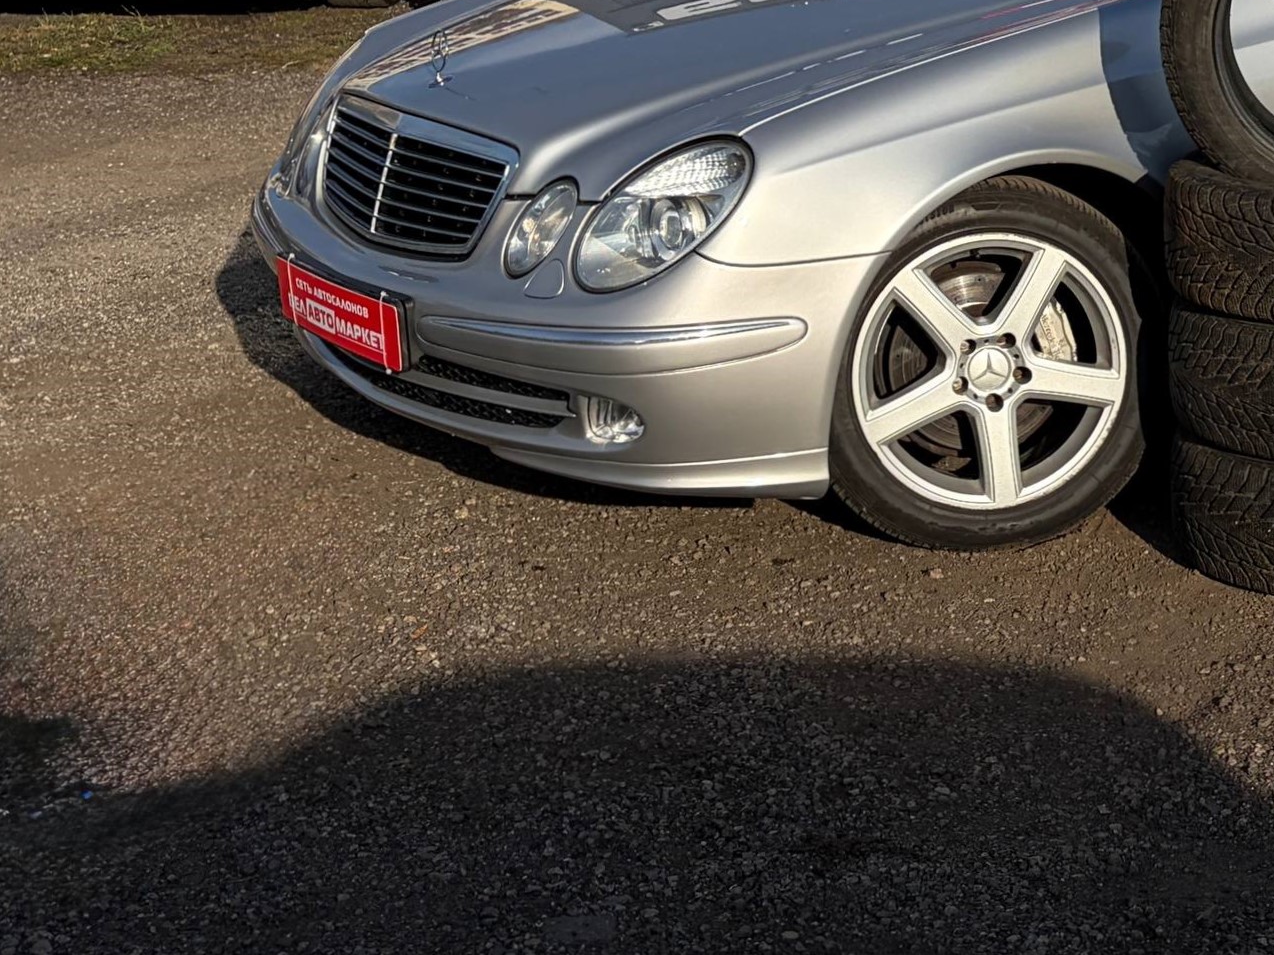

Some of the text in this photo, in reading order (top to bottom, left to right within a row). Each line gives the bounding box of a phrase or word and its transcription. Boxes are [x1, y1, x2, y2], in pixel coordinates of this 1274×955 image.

[295, 277, 369, 319] СЕТЬ АВТОСАЛОНОВ
[308, 300, 334, 330] АВТО
[336, 316, 384, 350] МАРКЕТ
